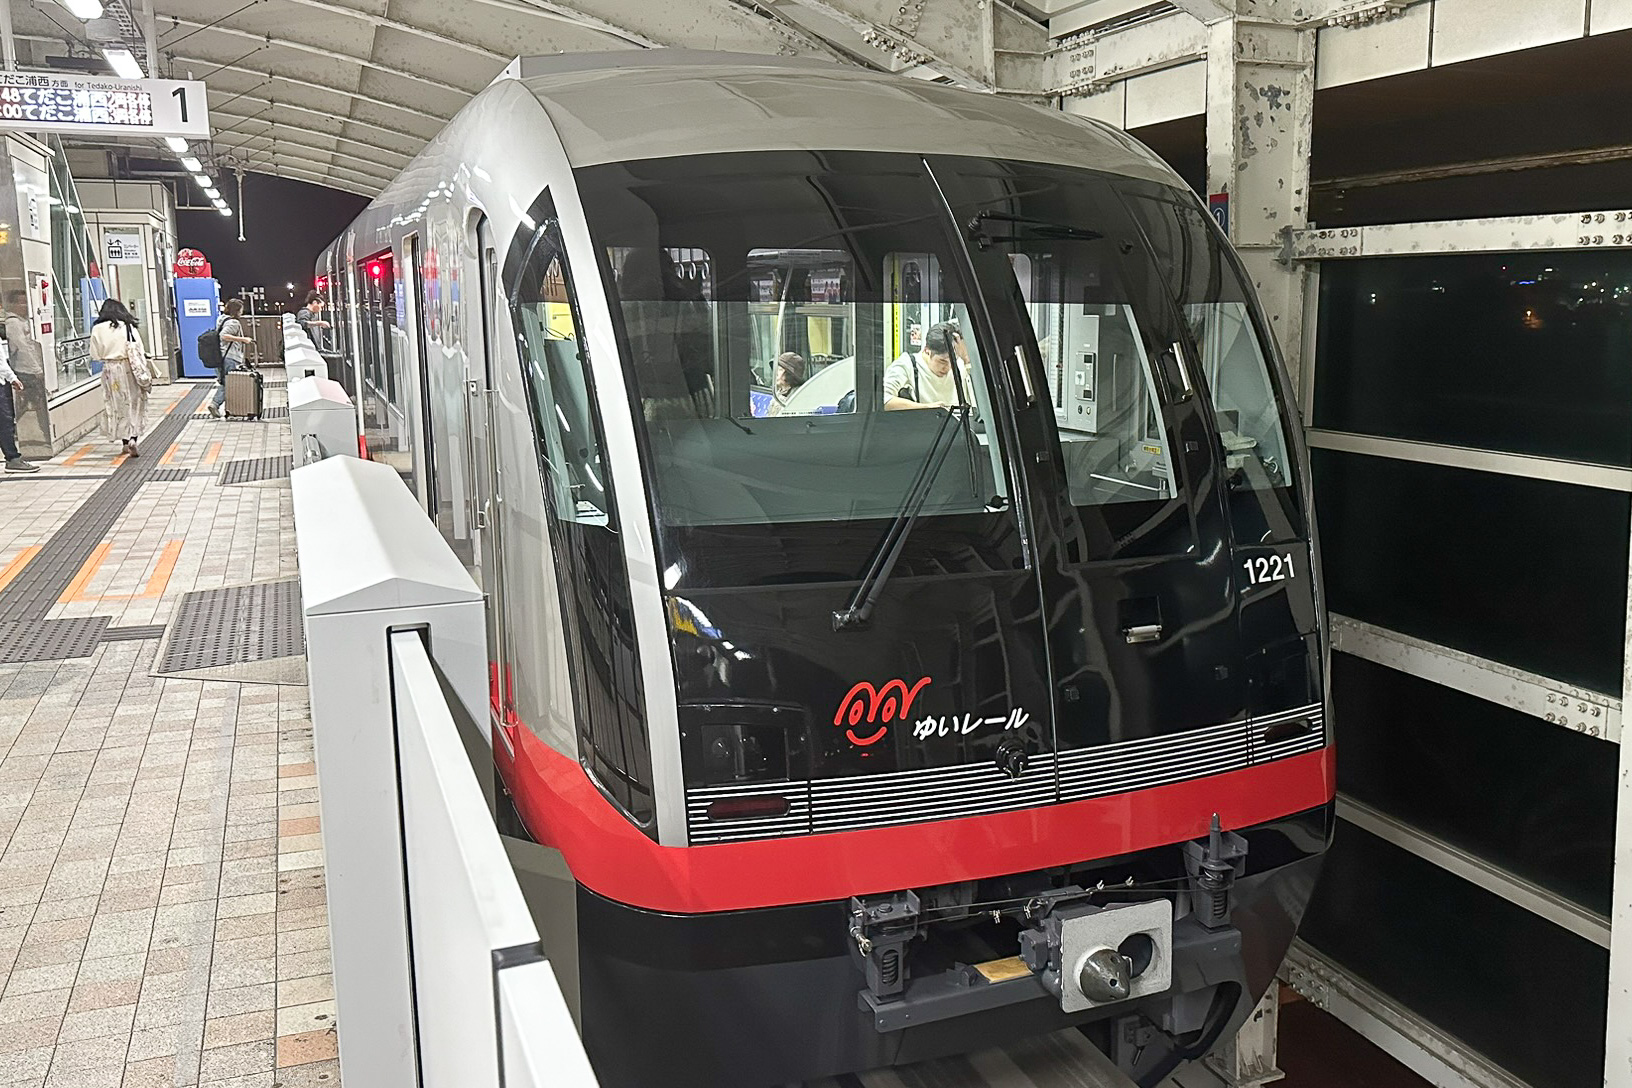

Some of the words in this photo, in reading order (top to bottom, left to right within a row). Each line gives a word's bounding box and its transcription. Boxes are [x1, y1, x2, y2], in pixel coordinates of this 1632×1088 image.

[0, 75, 49, 87] だこ浦西
[87, 82, 142, 91] Tedako-Uranishi
[171, 86, 188, 123] 1
[1243, 553, 1295, 585] 1221
[913, 707, 1030, 741] ゆいレール
